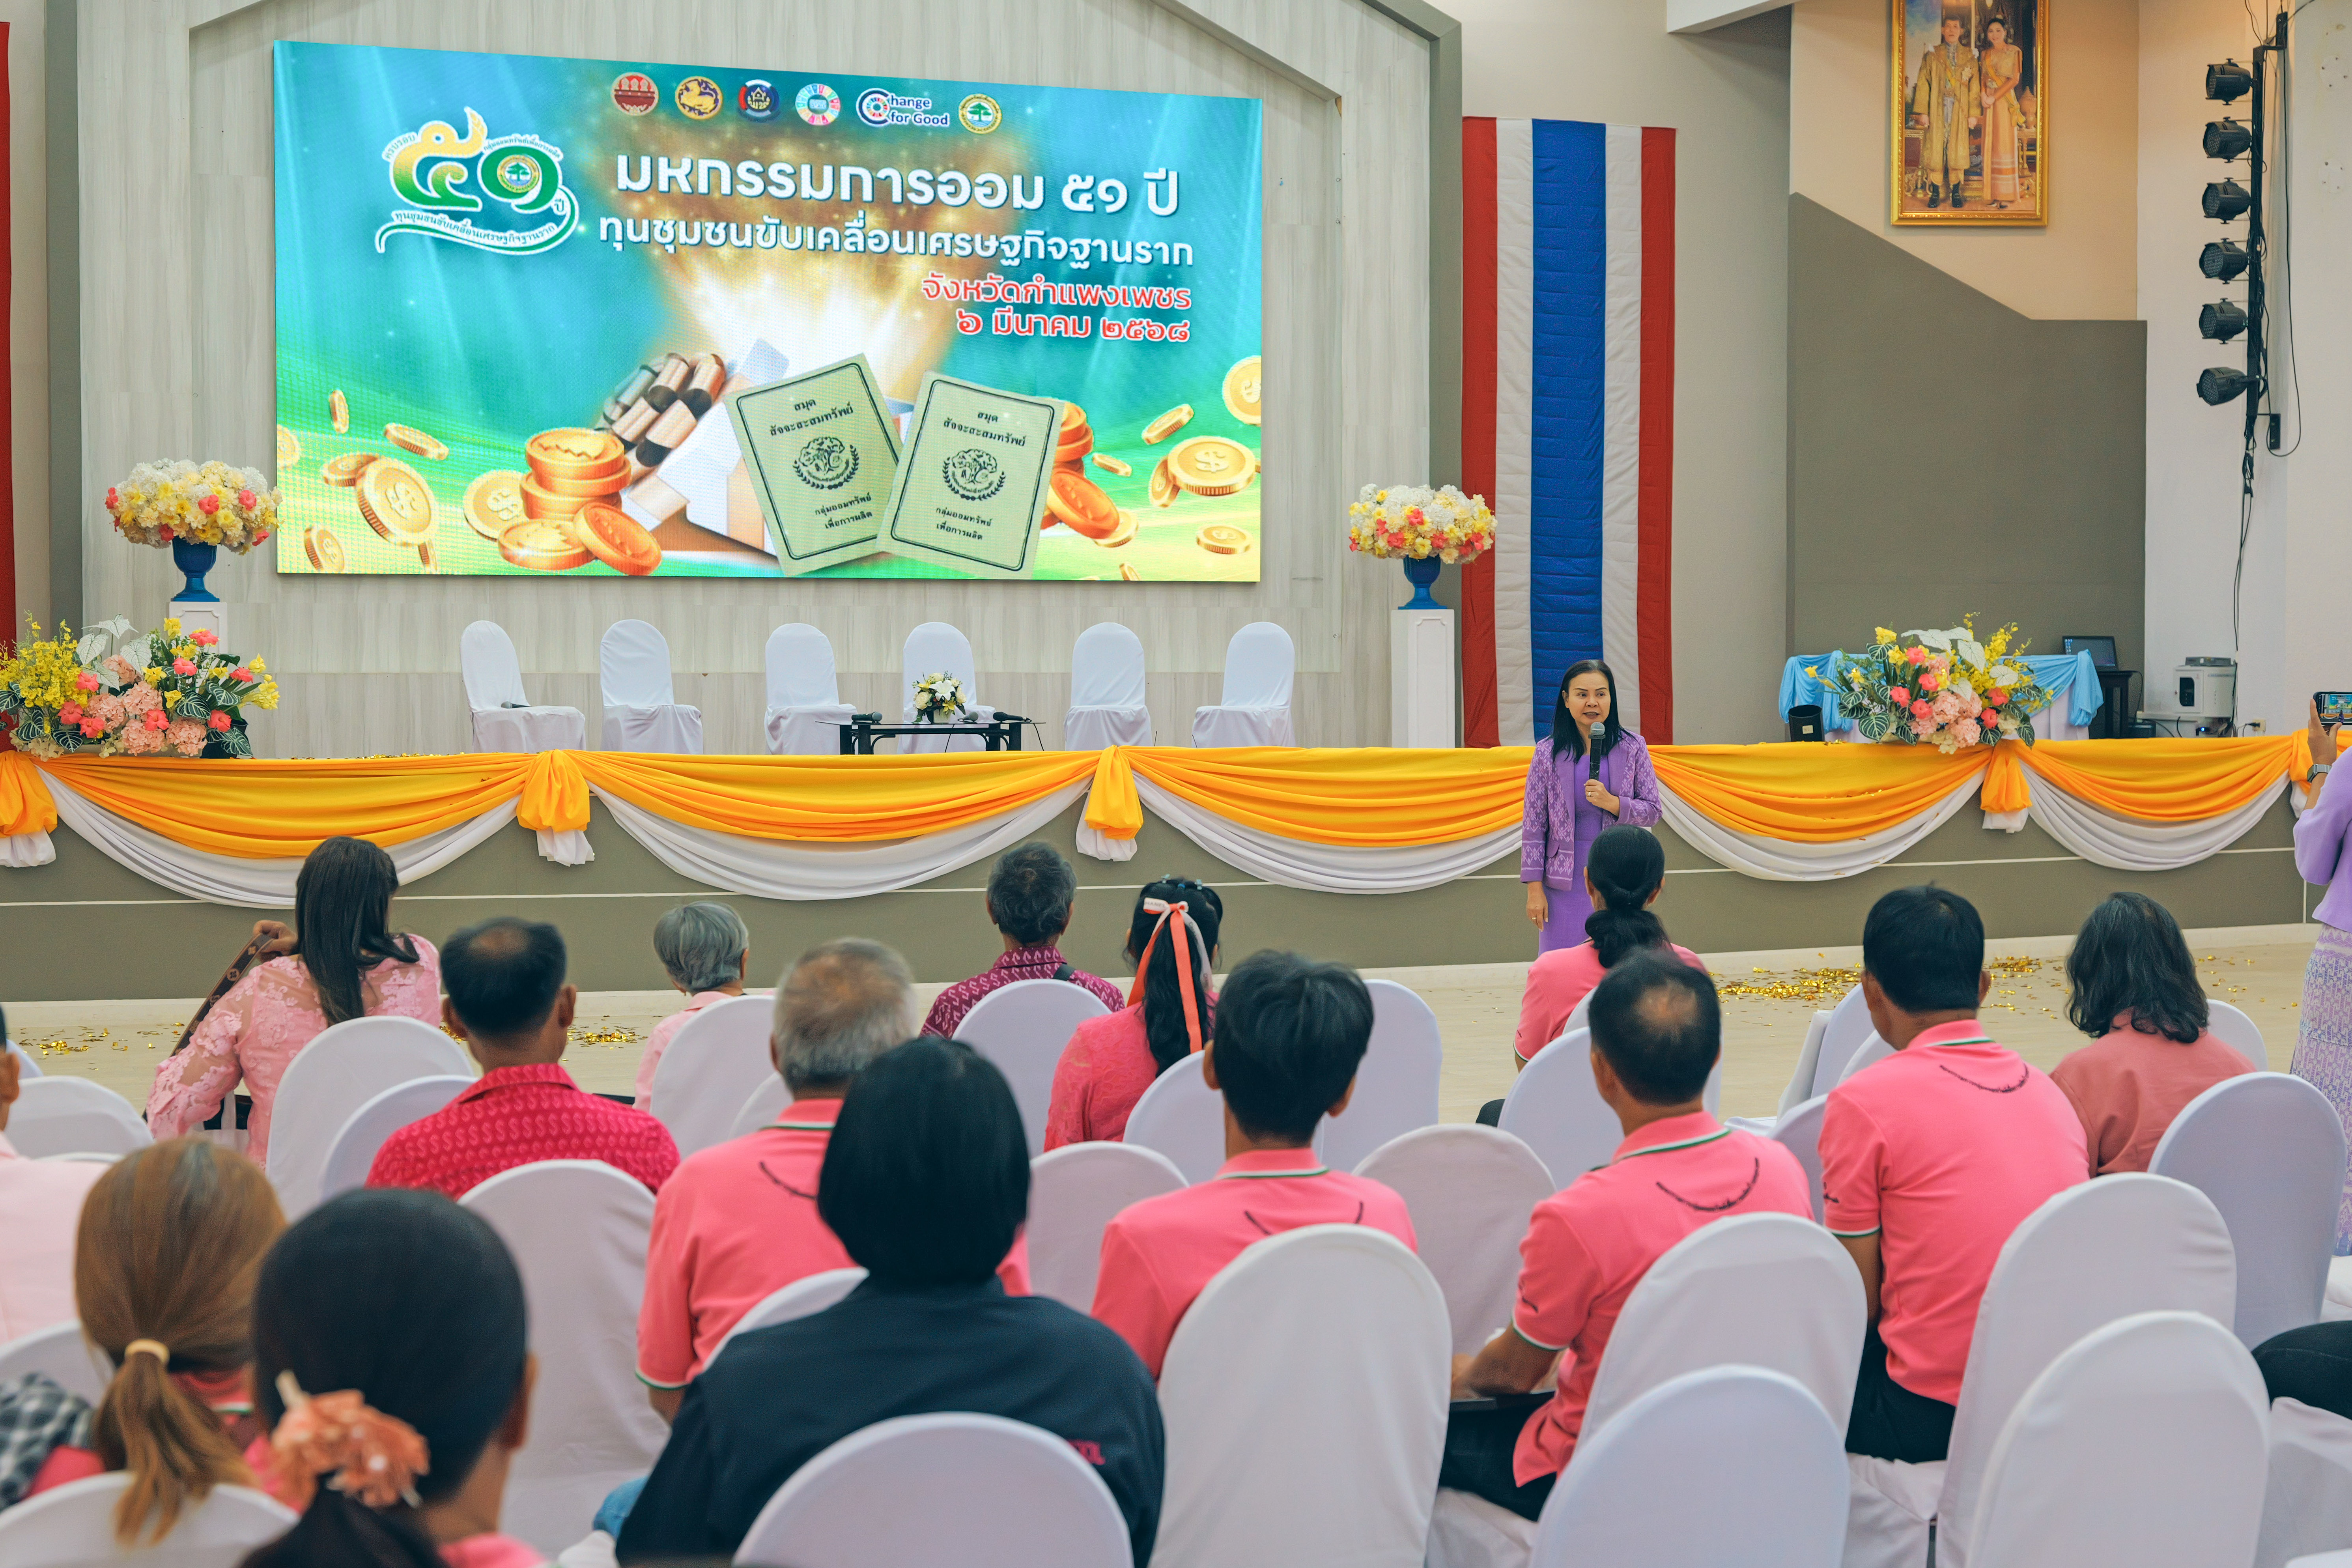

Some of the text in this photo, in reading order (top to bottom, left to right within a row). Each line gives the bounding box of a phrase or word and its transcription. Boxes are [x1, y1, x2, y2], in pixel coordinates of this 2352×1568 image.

[859, 90, 930, 124] Change
[891, 112, 948, 125] for Good
[617, 154, 1178, 217] มหกรรมการออม ๕๑ ปี
[600, 210, 1193, 269] ทุนชุมชนขับเคลื่อนเศรษฐกิจฐานราก
[922, 272, 1192, 310] จังหวัดกำแพงเพชร
[956, 306, 1192, 342] ๖ มีนาคม ๒๕๖๘
[794, 399, 816, 411] สมุด
[977, 412, 998, 424] สมุด
